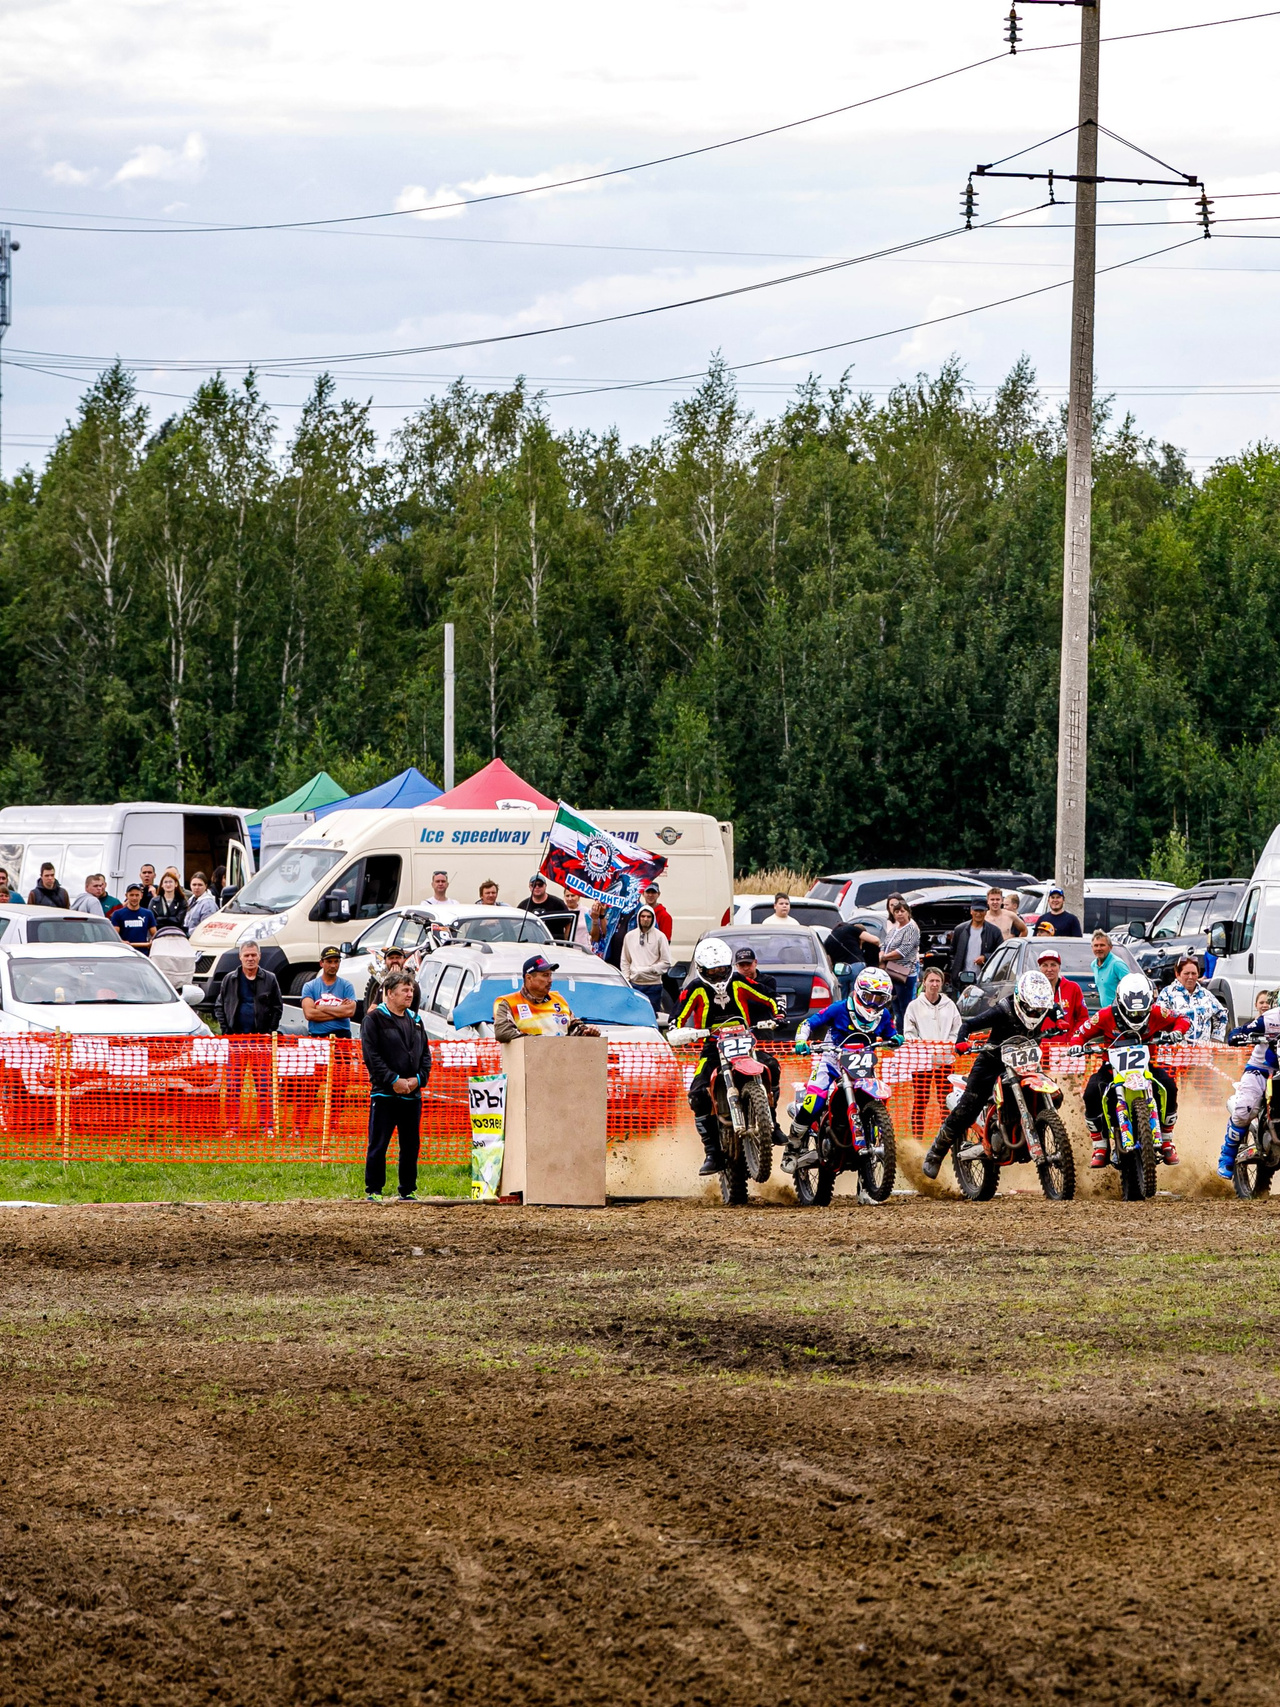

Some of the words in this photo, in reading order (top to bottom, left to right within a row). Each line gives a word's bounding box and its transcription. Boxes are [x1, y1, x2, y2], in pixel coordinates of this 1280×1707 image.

[420, 828, 444, 843] Ice
[451, 828, 531, 845] speedway
[566, 875, 625, 908] ШАДРИНСК
[554, 1003, 561, 1012] 5
[724, 1037, 752, 1058] 25
[848, 1053, 873, 1070] 24
[1010, 1048, 1039, 1067] 134
[1117, 1050, 1146, 1072] 12
